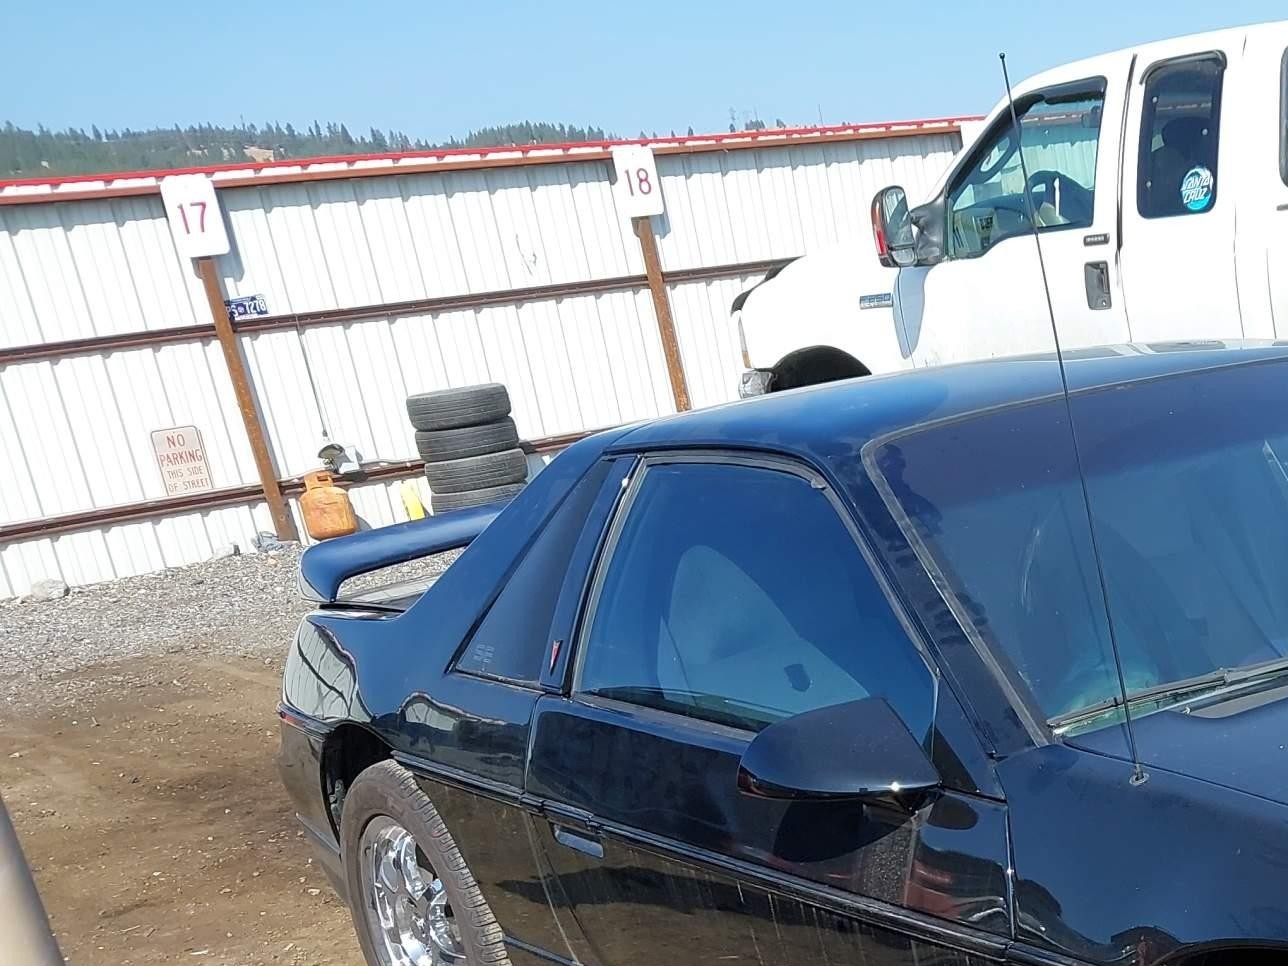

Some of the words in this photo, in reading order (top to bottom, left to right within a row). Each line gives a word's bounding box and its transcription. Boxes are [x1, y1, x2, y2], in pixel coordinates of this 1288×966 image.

[624, 167, 652, 197] 18
[176, 201, 207, 235] 17
[243, 300, 267, 315] 7278
[166, 433, 186, 449] NO
[159, 448, 203, 467] PARKING
[167, 468, 184, 479] THIS
[186, 465, 204, 476] SIDE
[168, 482, 179, 493] OF
[182, 478, 209, 490] STREET
